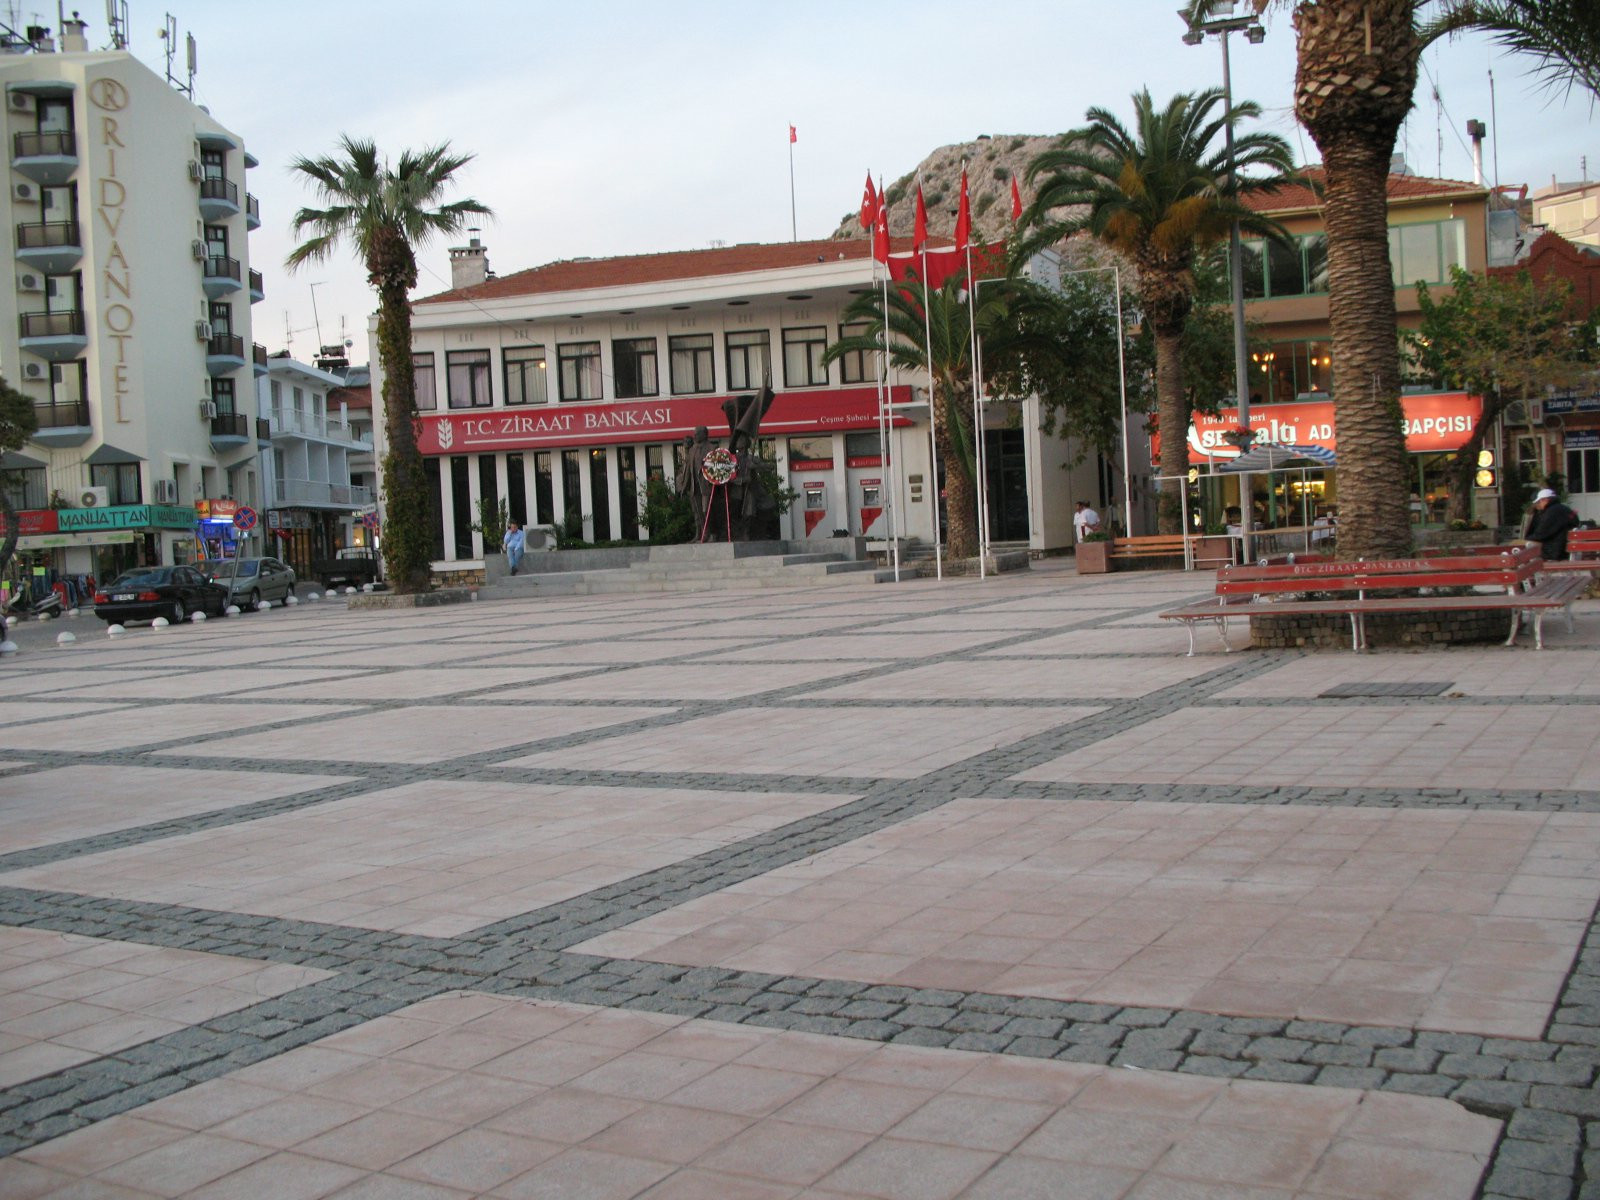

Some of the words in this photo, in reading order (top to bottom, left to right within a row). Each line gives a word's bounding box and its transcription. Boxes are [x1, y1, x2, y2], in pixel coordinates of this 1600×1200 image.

[97, 116, 131, 299] RIDVAN
[104, 303, 133, 424] OTEL
[462, 418, 496, 436] T.C.
[500, 415, 574, 434] ZİRAAT
[584, 408, 671, 429] BANKASI
[820, 415, 845, 425] Çeşme
[846, 413, 870, 423] Şubesi
[60, 507, 148, 530] MANHATTAN
[157, 510, 194, 524] MANHATTAN
